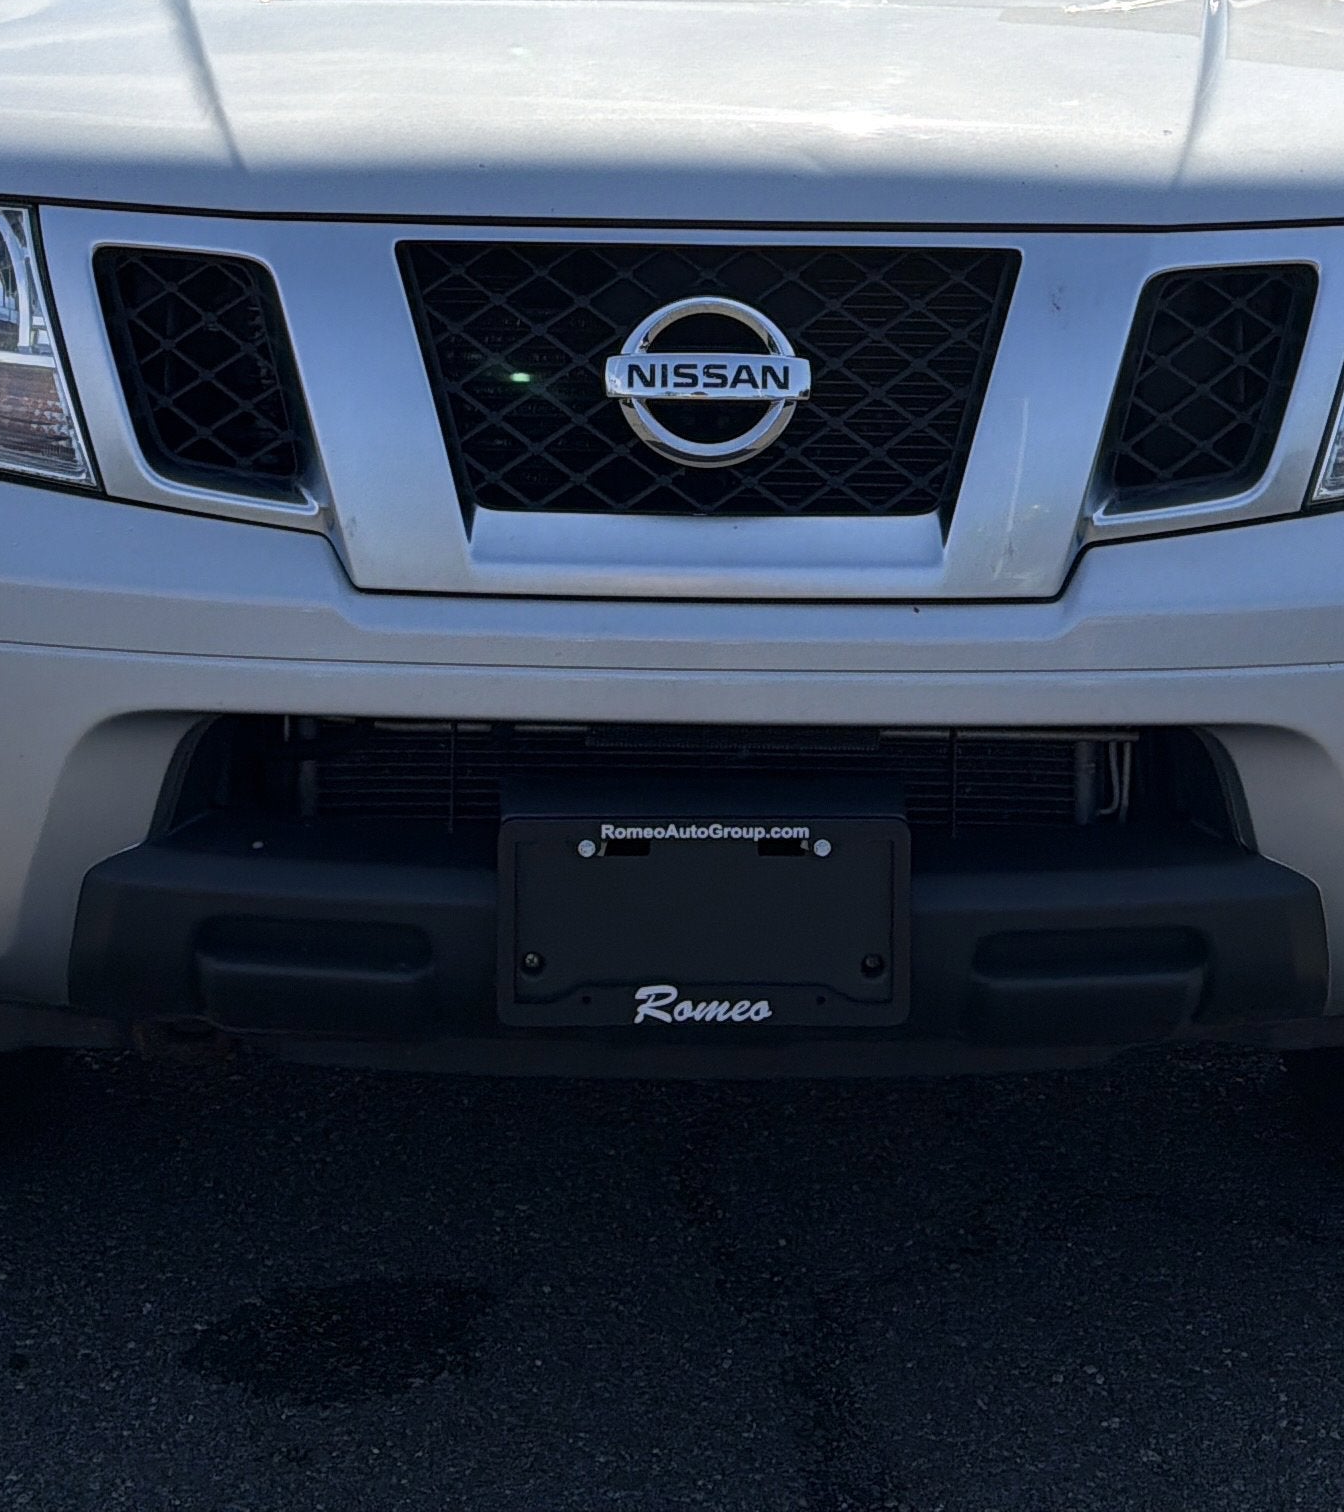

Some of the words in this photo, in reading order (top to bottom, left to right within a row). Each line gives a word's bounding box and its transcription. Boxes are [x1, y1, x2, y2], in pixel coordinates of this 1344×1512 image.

[626, 363, 791, 391] NISSAN
[600, 823, 810, 842] RomeoAutoGroup.com
[633, 984, 773, 1025] Romeo
